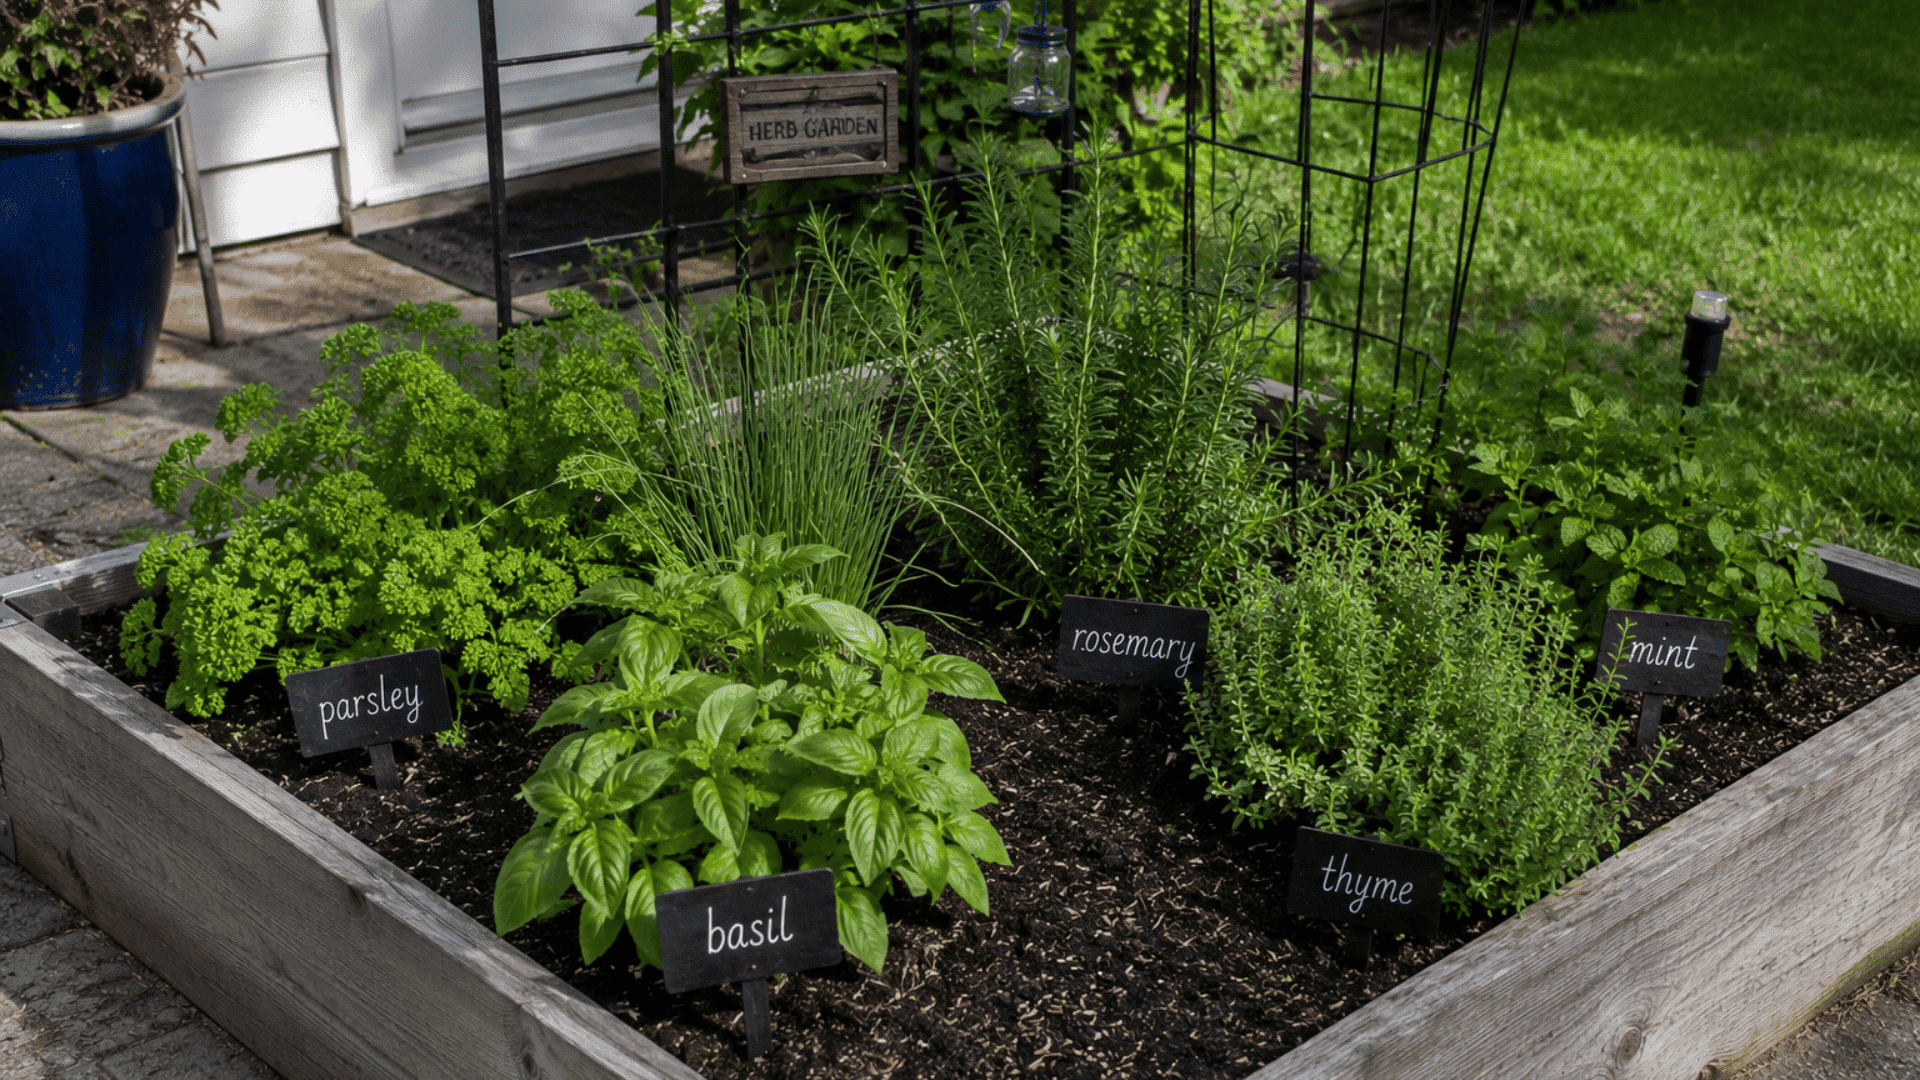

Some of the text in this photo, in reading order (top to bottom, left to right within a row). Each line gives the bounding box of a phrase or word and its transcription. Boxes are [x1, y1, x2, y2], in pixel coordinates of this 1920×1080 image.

[748, 120, 798, 141] HERB
[1072, 628, 1196, 678] rosemary
[1627, 635, 1699, 670] mint
[318, 674, 423, 739] parsley
[1321, 854, 1413, 914] thyme
[707, 896, 794, 955] basil
